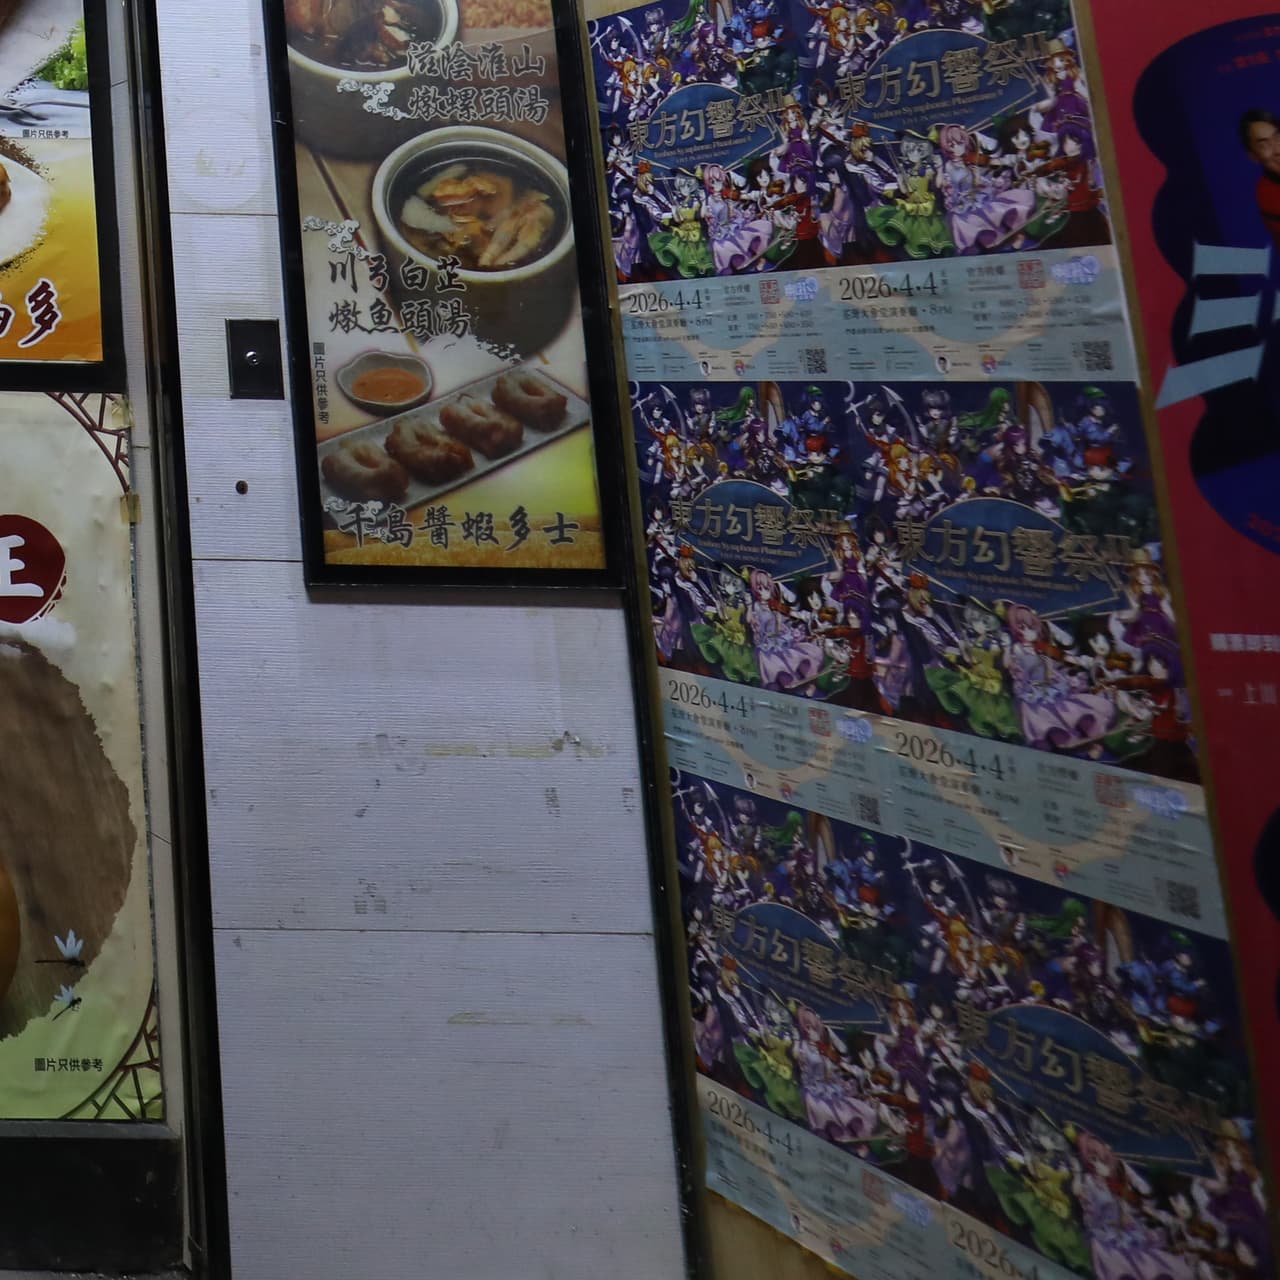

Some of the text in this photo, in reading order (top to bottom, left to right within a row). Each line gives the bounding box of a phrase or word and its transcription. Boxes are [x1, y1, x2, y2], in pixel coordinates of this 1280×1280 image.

[407, 85, 550, 125] 燉螺頭湯
[328, 299, 473, 339] 燉魚頭湯
[339, 502, 581, 552] 千島醬蝦多士
[33, 1057, 104, 1073] 圖片只供參考
